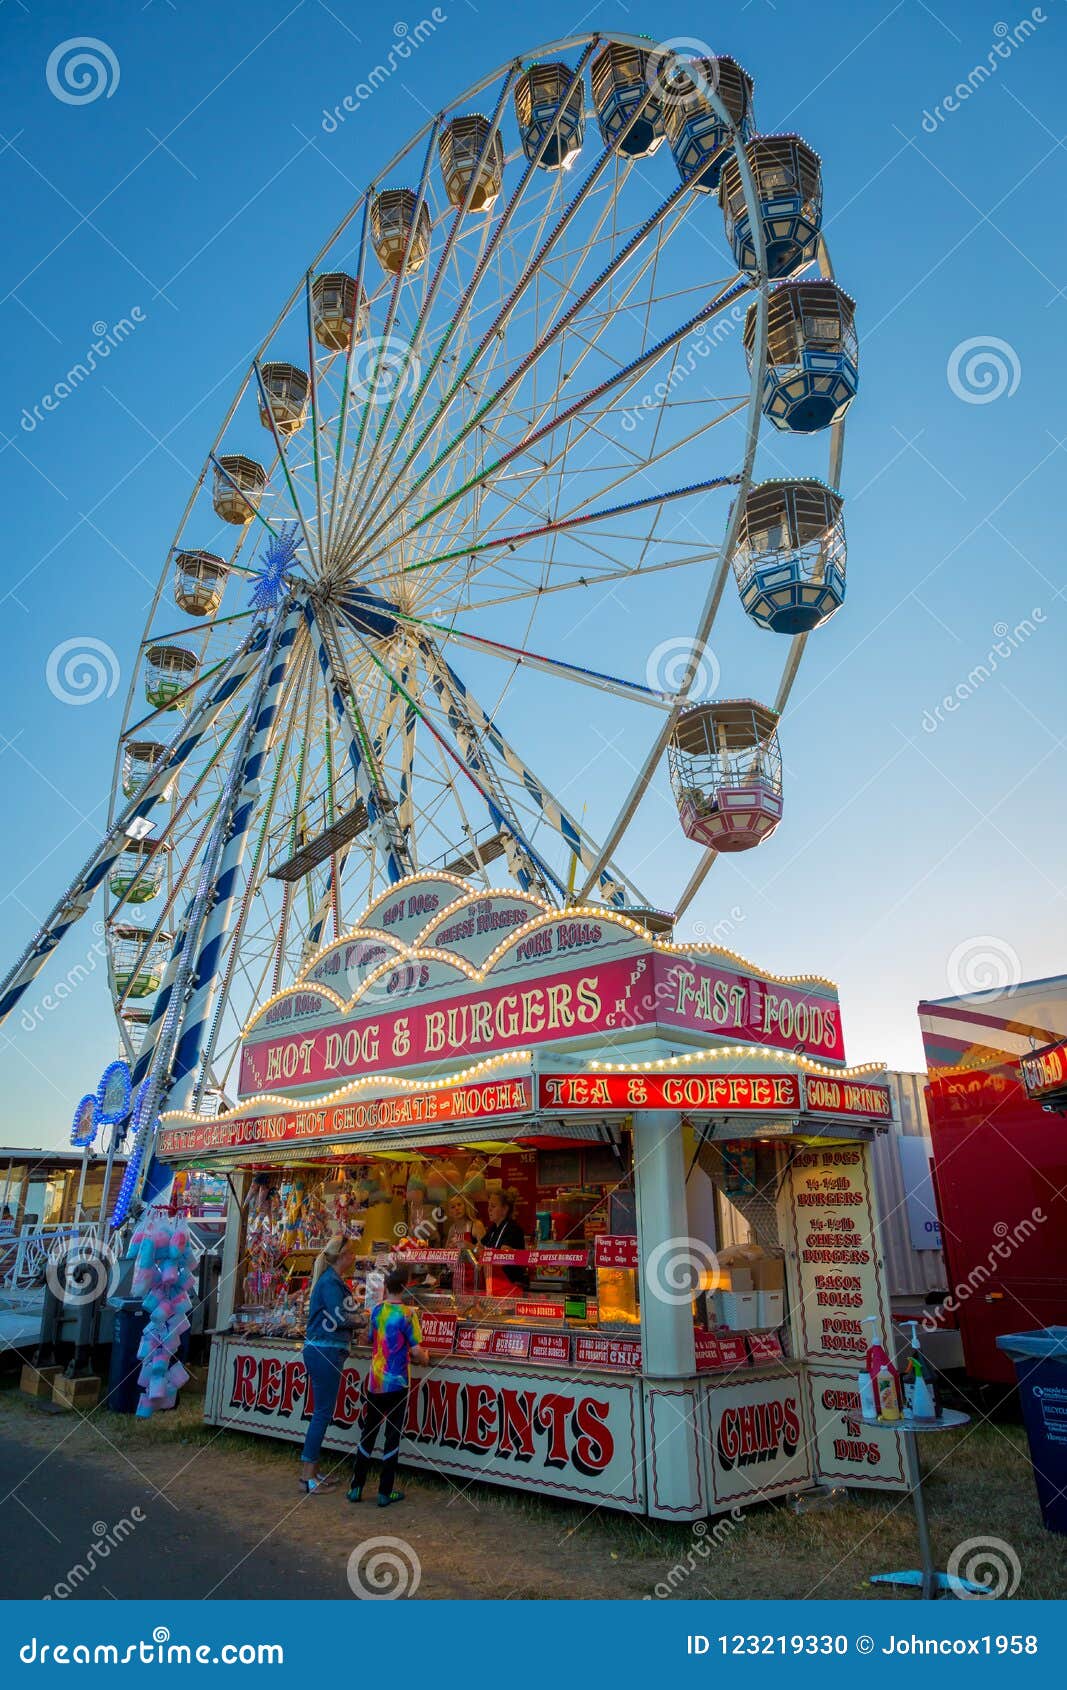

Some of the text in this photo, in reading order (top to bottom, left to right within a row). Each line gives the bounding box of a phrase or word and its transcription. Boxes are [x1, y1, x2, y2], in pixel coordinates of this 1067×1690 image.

[383, 894, 439, 926] HOT DOGS
[436, 909, 528, 945] CHEESE BURGERS
[516, 923, 602, 962] PORK ROLLS
[387, 965, 430, 993] CHIPS
[675, 971, 837, 1049] FAST FOODS
[266, 975, 601, 1081] HOT DOG & BURGERS
[1025, 1051, 1062, 1090] COLD
[546, 1078, 795, 1105] TEA & COFFEE
[807, 1079, 890, 1115] COLD DRINKS
[793, 1151, 860, 1168] HOT DOGS
[797, 1192, 863, 1207] BURGERS
[806, 1234, 862, 1248] CHEESE
[802, 1249, 870, 1264] BURGERS
[815, 1276, 861, 1291] BACON
[817, 1291, 863, 1308] ROLLS
[822, 1318, 863, 1335] PORK
[821, 1335, 868, 1352] ROLLS
[610, 1351, 641, 1366] CHIP
[718, 1397, 799, 1471] CHIPS
[834, 1439, 881, 1464] DIPS
